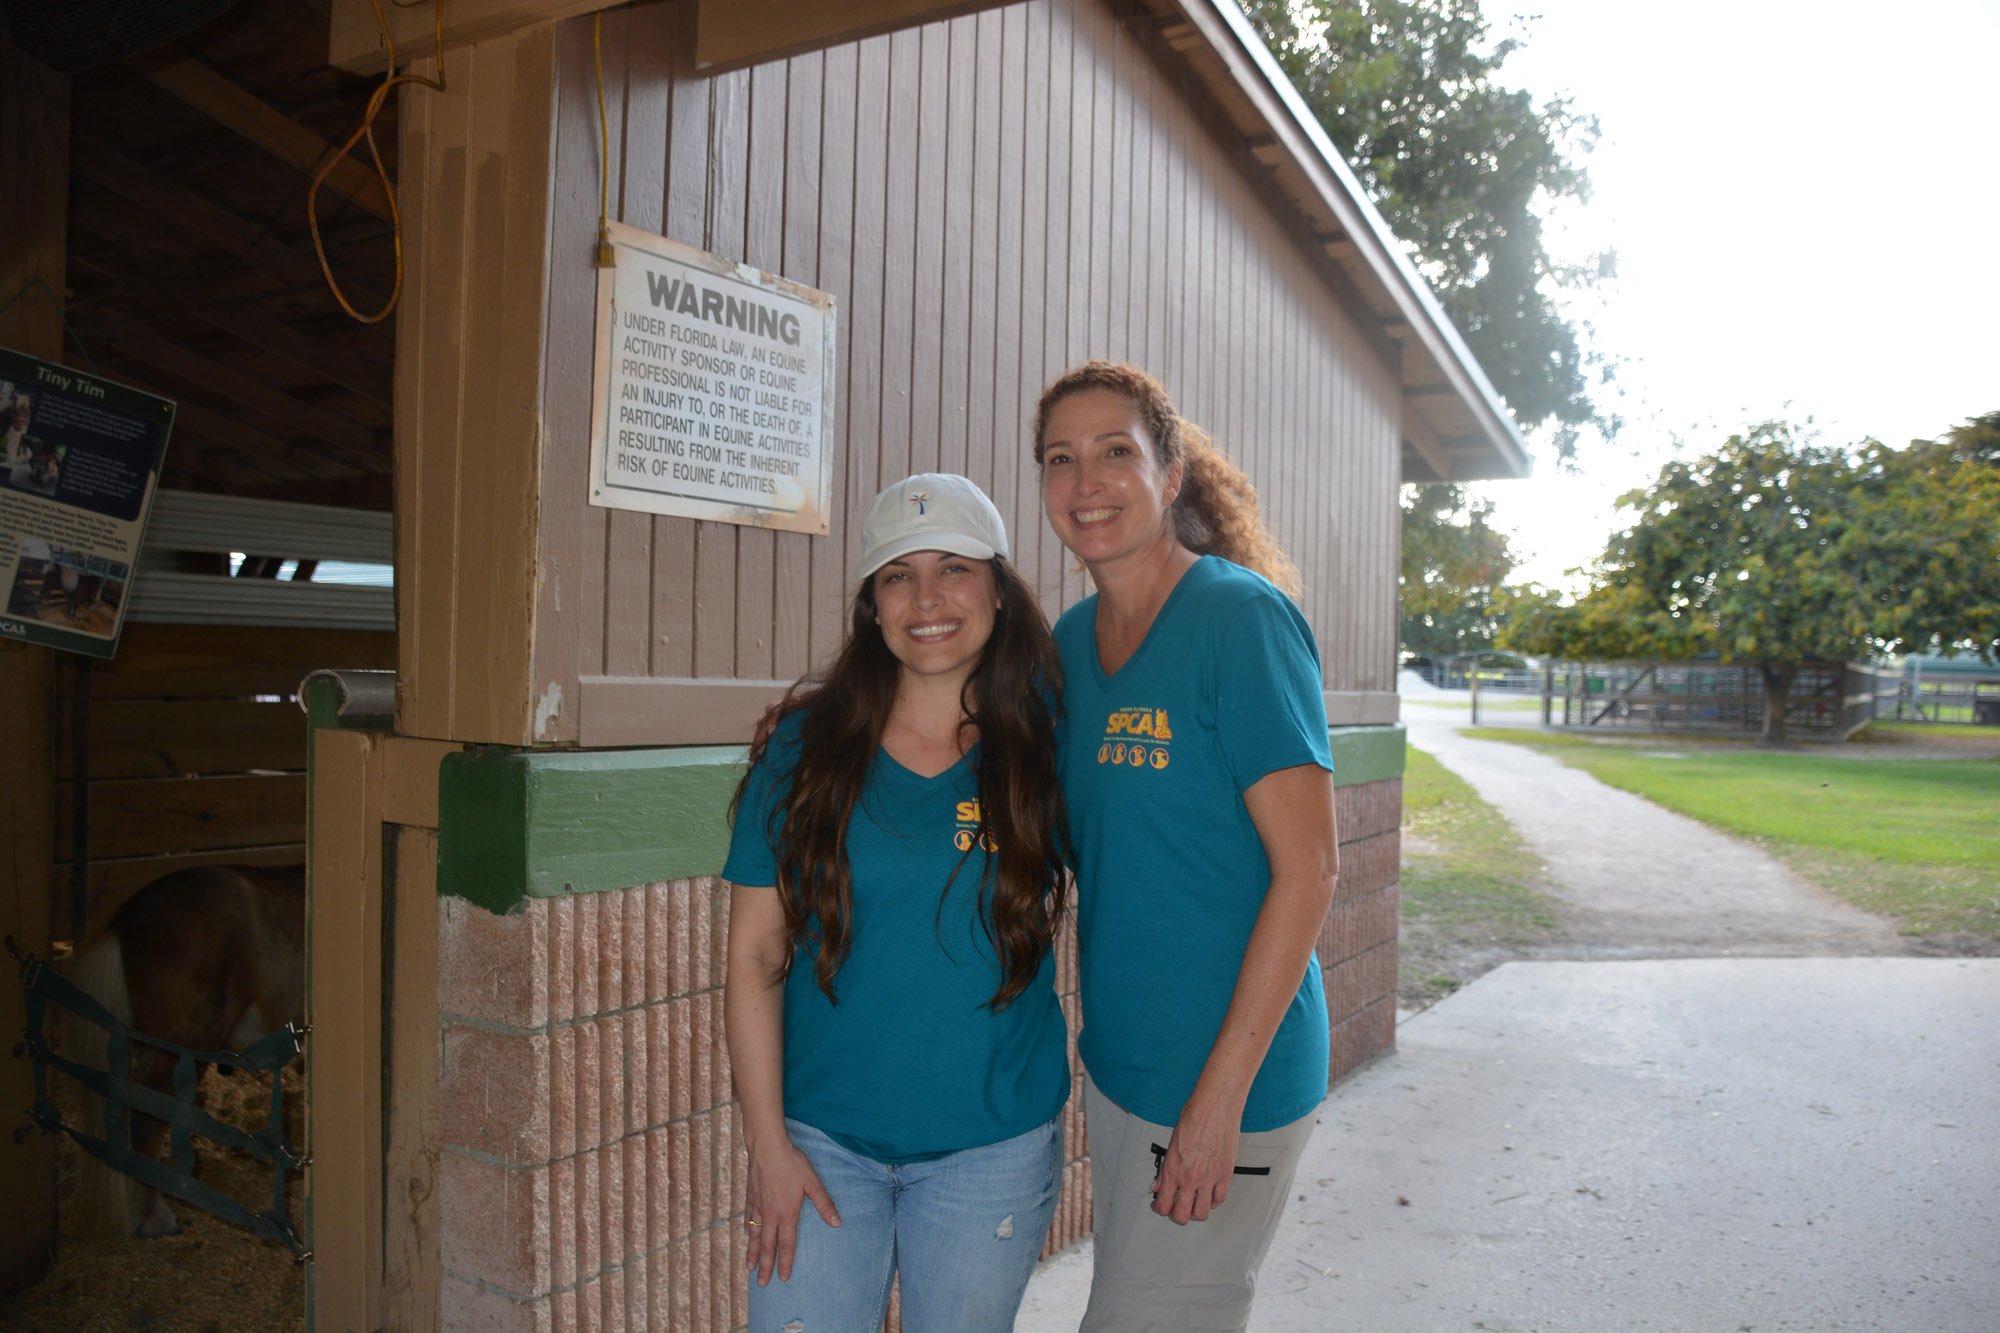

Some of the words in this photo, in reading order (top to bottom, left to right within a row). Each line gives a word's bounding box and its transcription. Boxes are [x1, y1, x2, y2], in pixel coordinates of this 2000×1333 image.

[646, 270, 800, 348] WARNING
[623, 335, 676, 362] ACTIVITY
[681, 349, 736, 377] SPONSOR
[740, 364, 755, 382] OR
[760, 369, 796, 393] EQUINE
[624, 311, 665, 337] UNDER
[671, 323, 718, 351] FLORIDA
[752, 346, 766, 363] AN
[769, 350, 806, 374] EQUINE
[36, 366, 72, 391] Tiny
[75, 378, 106, 400] Tim
[622, 359, 710, 394] PROFESSIONAL
[715, 380, 726, 397] IS
[729, 384, 751, 403] NOT
[755, 389, 788, 412] LIABLE
[792, 399, 812, 417] FOR
[620, 406, 694, 436] PARTICIPANT
[699, 422, 710, 439] IN
[714, 425, 754, 447] EQUINE
[758, 434, 810, 458] ACTIVITIES
[621, 383, 639, 401] AN
[643, 386, 684, 410] INJURY
[688, 396, 705, 418] TO,
[709, 401, 725, 419] OR
[729, 406, 749, 424] THE
[753, 411, 786, 432] DEATH
[806, 423, 813, 438] A
[618, 453, 647, 474] RISK
[652, 459, 668, 477] OF
[673, 462, 715, 485] EQUINE
[719, 471, 777, 495] ACTIVITIES.
[619, 429, 685, 457] RESULTING
[689, 442, 721, 463] FROM
[726, 449, 746, 468] THE
[750, 454, 800, 477] INHERENT
[1106, 712, 1153, 736] SPCA
